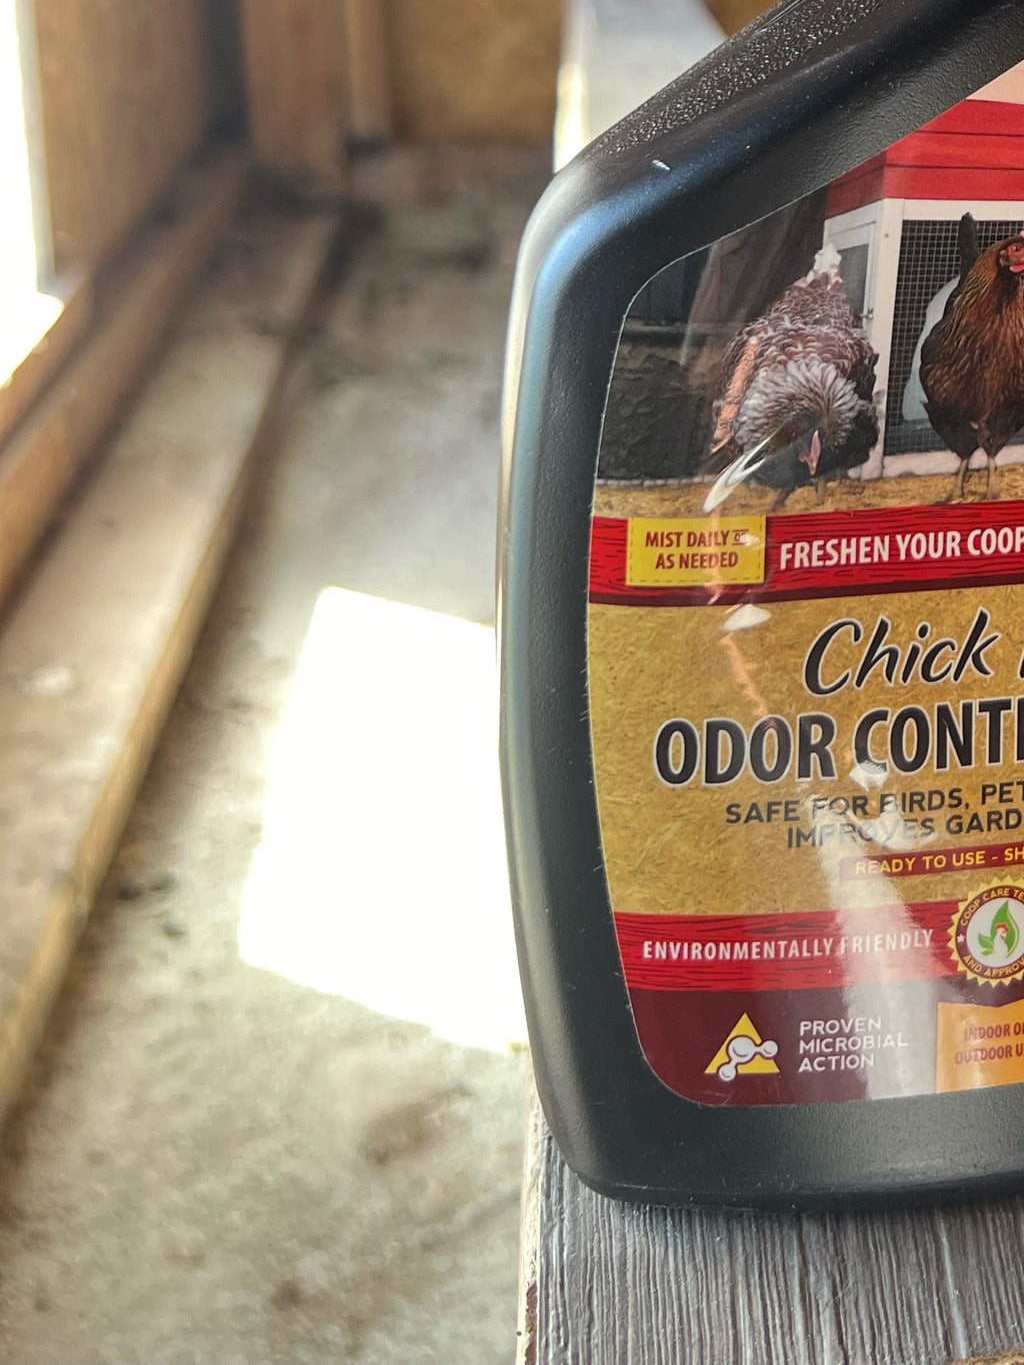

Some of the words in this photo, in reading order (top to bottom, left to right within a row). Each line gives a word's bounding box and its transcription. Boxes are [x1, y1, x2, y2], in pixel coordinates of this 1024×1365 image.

[645, 531, 683, 548] MIST
[687, 530, 730, 547] DAILY
[780, 535, 890, 571] FRESHEN
[896, 530, 961, 561] YOUR
[655, 553, 675, 570] AS
[679, 551, 739, 570] NEEDED
[804, 606, 999, 696] Chick
[655, 714, 837, 786] ODOR
[725, 799, 800, 824] SAFE
[811, 795, 869, 819] FOR
[880, 787, 970, 816] BIRDS,
[788, 817, 936, 849] IMPROVES
[855, 857, 916, 875] READY
[922, 854, 947, 870] TO
[952, 850, 986, 866] USE
[960, 899, 981, 926] COOP
[982, 888, 1010, 901] CARE
[643, 936, 833, 961] ENVIRONMENTALLY
[840, 929, 934, 954] FRIENDLY
[963, 955, 982, 973] AND
[800, 1017, 881, 1037] PROVEN
[964, 1023, 1011, 1041] INDOOR
[799, 1031, 908, 1055] MICROBIAL
[955, 1045, 1012, 1064] OUTDOOR
[798, 1053, 875, 1073] ACTION
